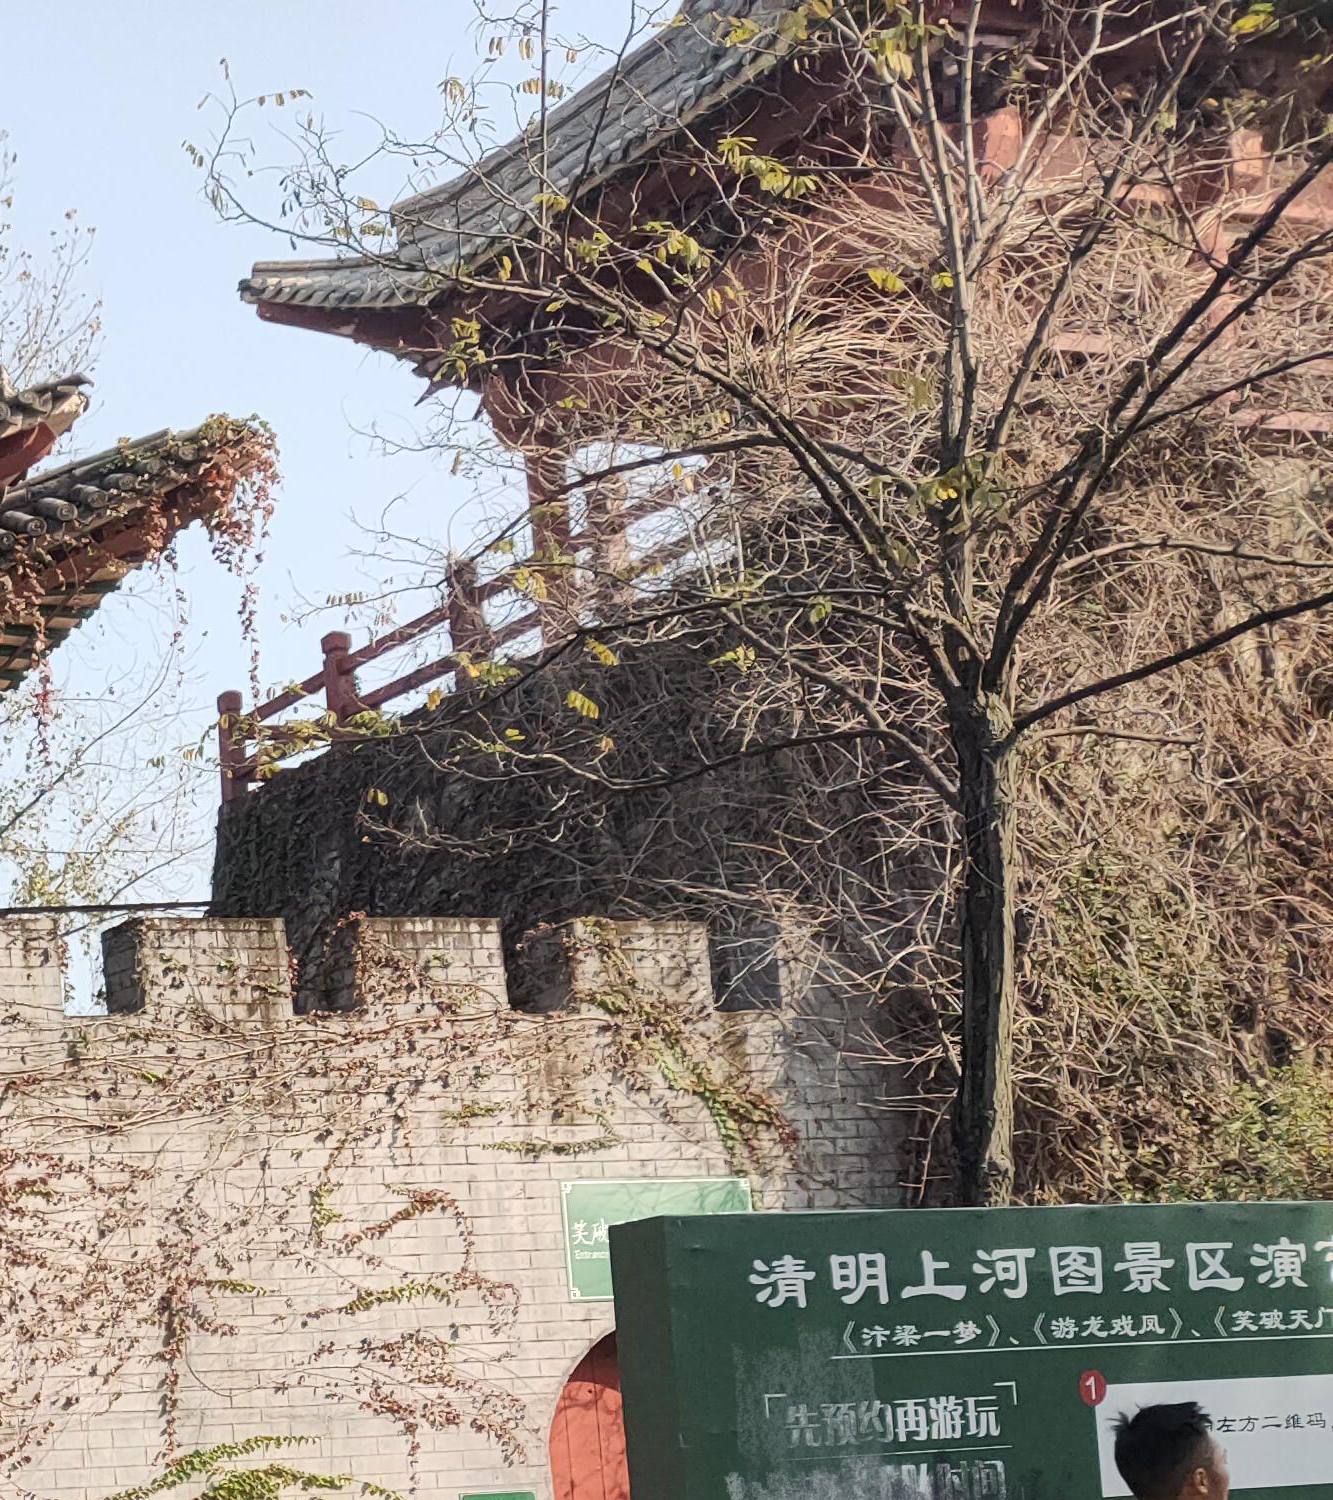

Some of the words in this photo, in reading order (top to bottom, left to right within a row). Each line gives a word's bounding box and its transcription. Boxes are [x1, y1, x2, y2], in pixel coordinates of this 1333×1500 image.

[1209, 1412, 1327, 1433] 左方二维码
